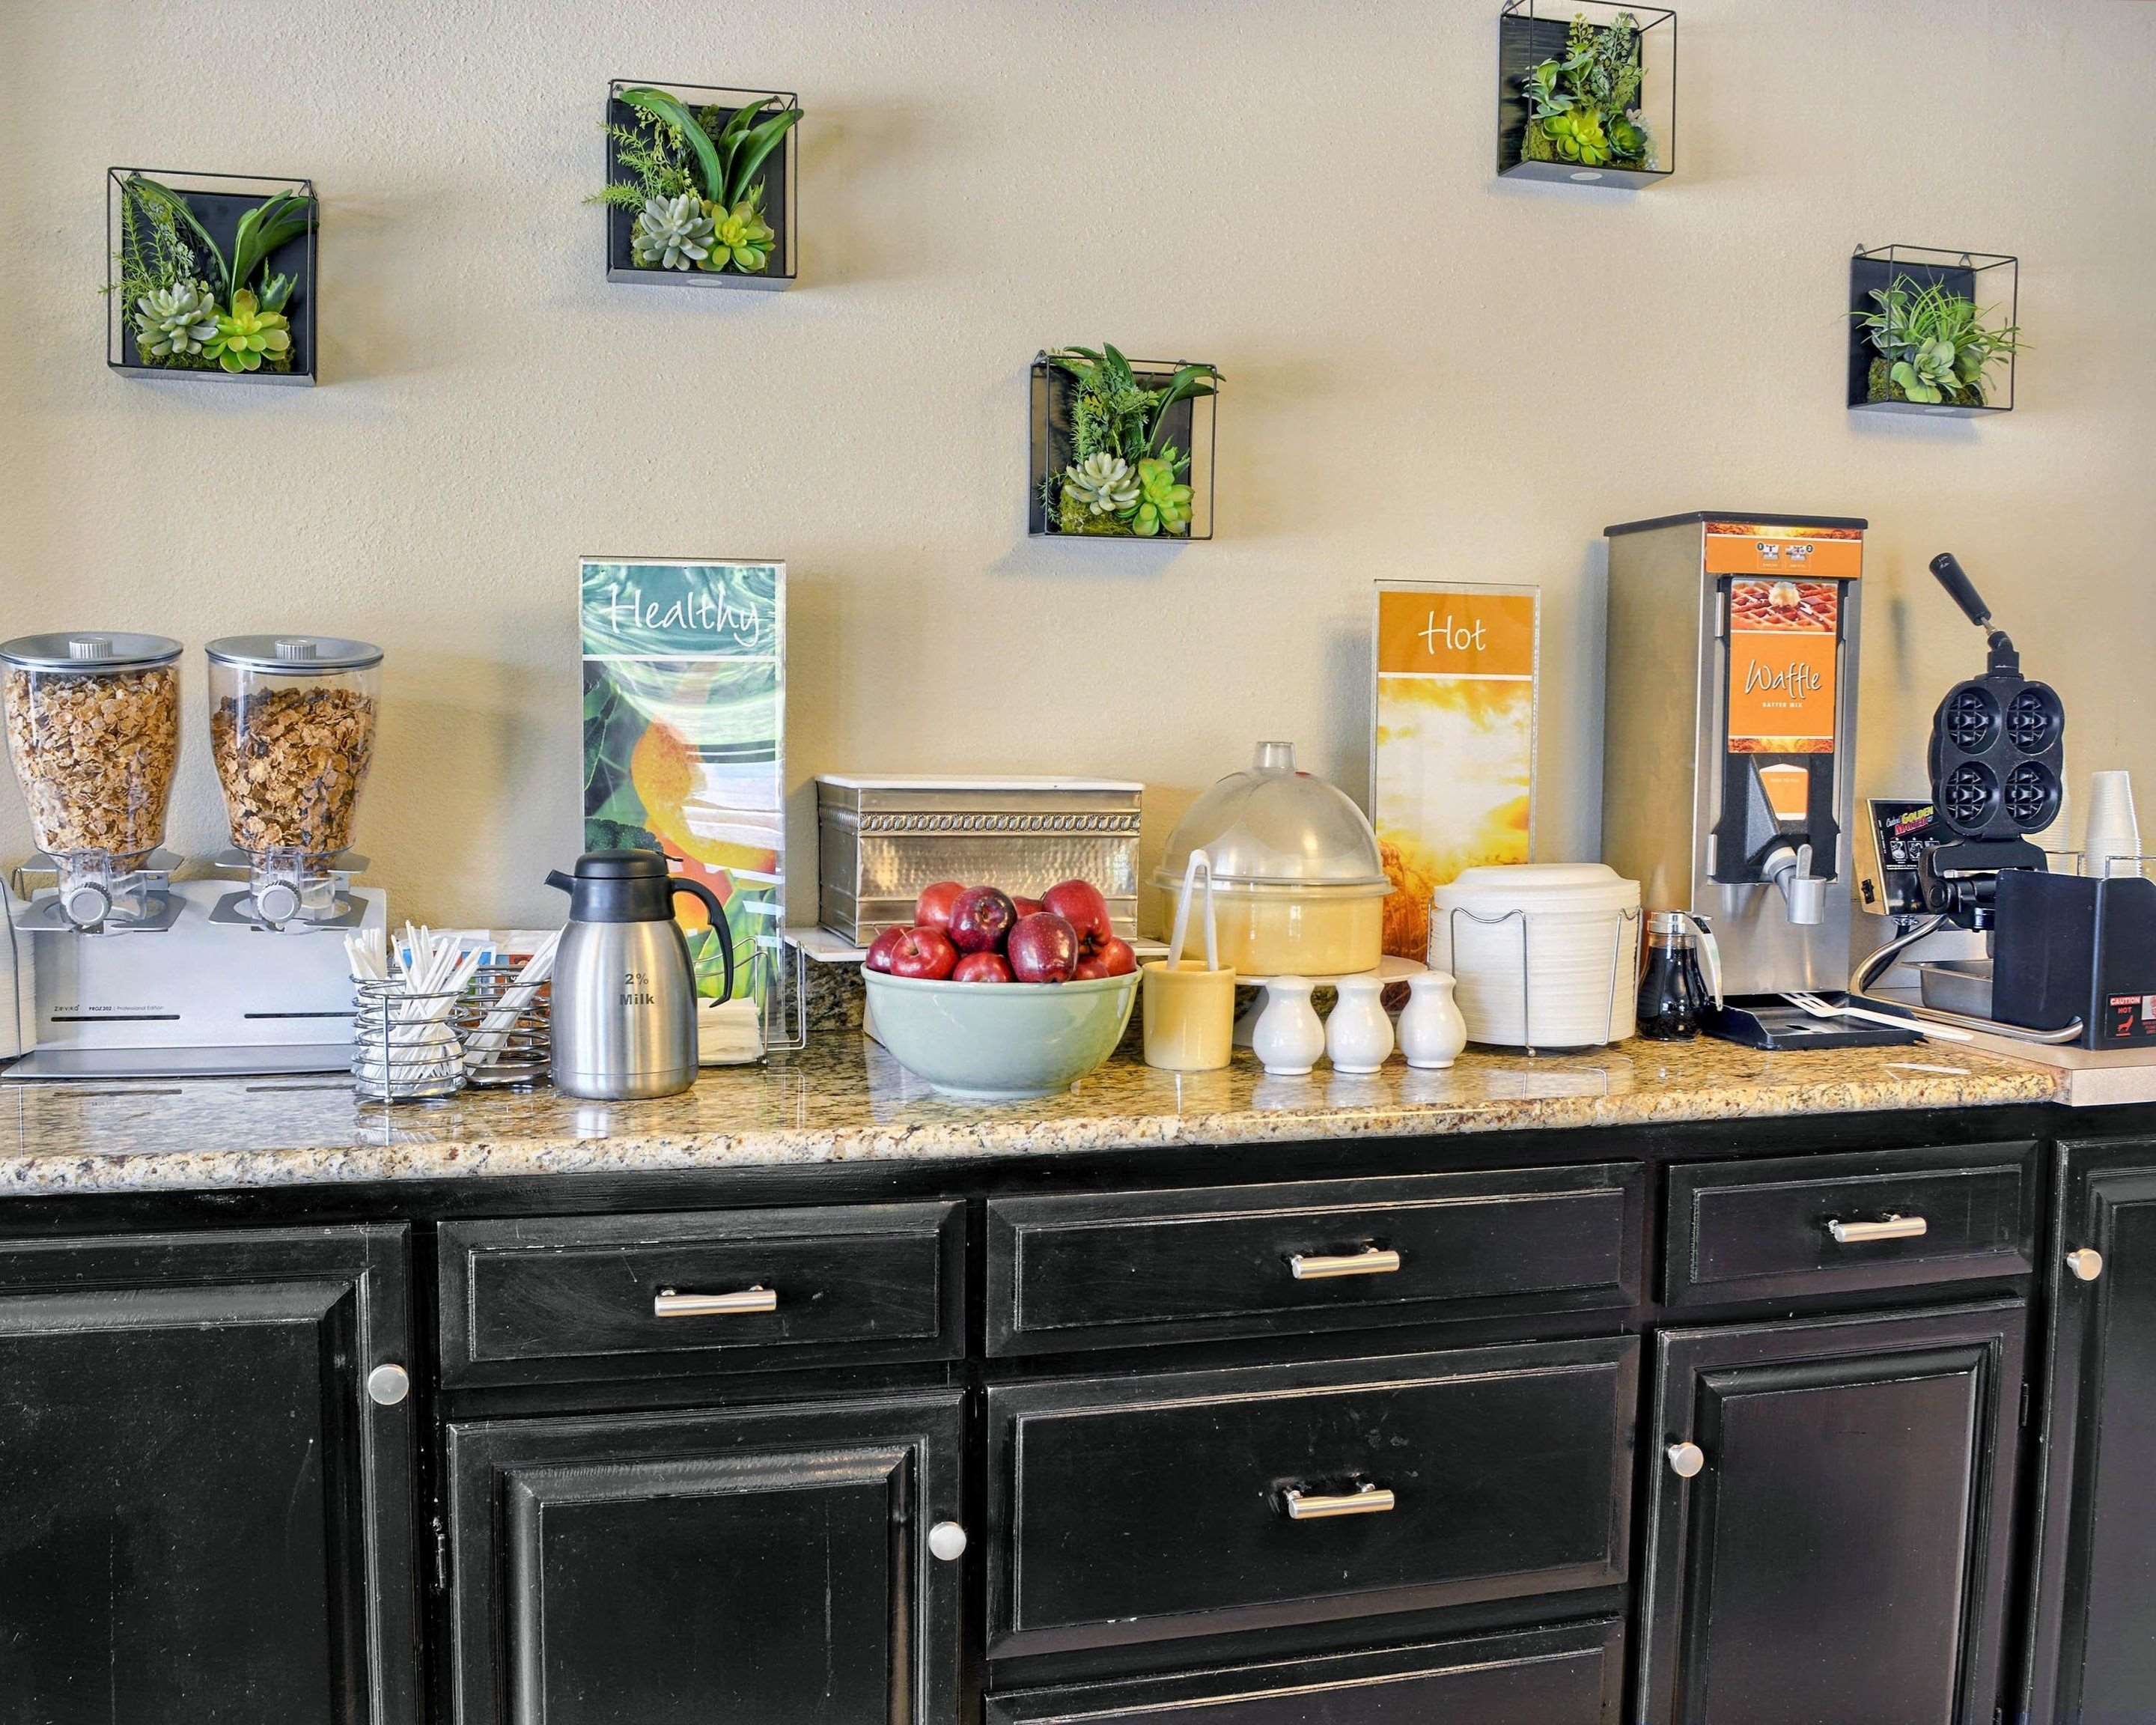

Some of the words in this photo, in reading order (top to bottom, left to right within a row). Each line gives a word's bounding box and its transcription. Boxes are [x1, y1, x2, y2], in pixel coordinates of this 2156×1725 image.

[600, 582, 760, 648] Healthy
[1418, 611, 1486, 655] Hot
[1744, 659, 1821, 699] Waffle
[624, 973, 649, 985] 2%
[620, 994, 654, 1005] Milk
[2110, 997, 2140, 1006] CAUTION
